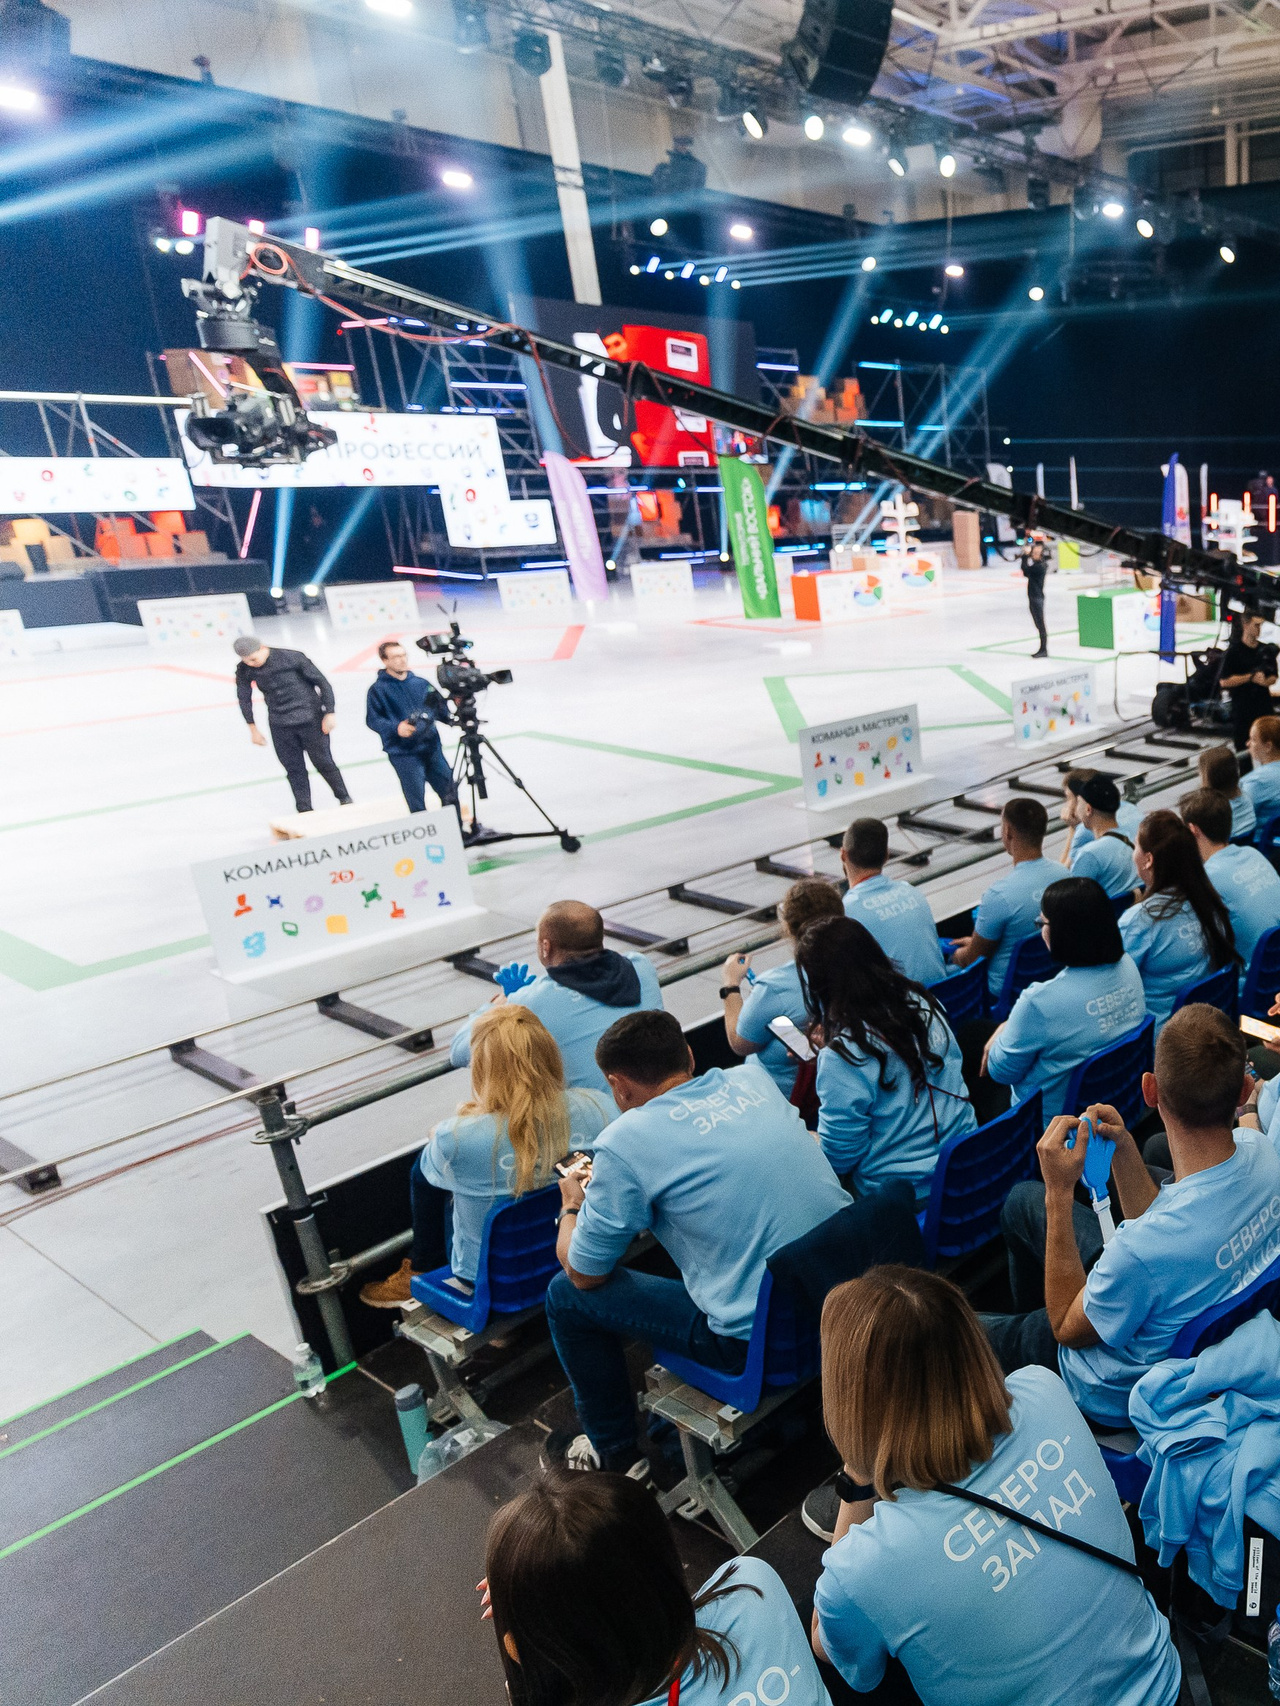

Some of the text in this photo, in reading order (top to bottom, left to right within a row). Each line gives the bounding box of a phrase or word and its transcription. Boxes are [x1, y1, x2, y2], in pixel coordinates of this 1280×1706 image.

[811, 713, 910, 744] КОМАНДА МАСТЕРОВ
[223, 823, 438, 884] КОМАНДА МАСТЕРОВ
[692, 1090, 770, 1136] ЗАПАД
[943, 1435, 1071, 1562] СЕВЕРО-
[981, 1468, 1097, 1593] ЗАПАД
